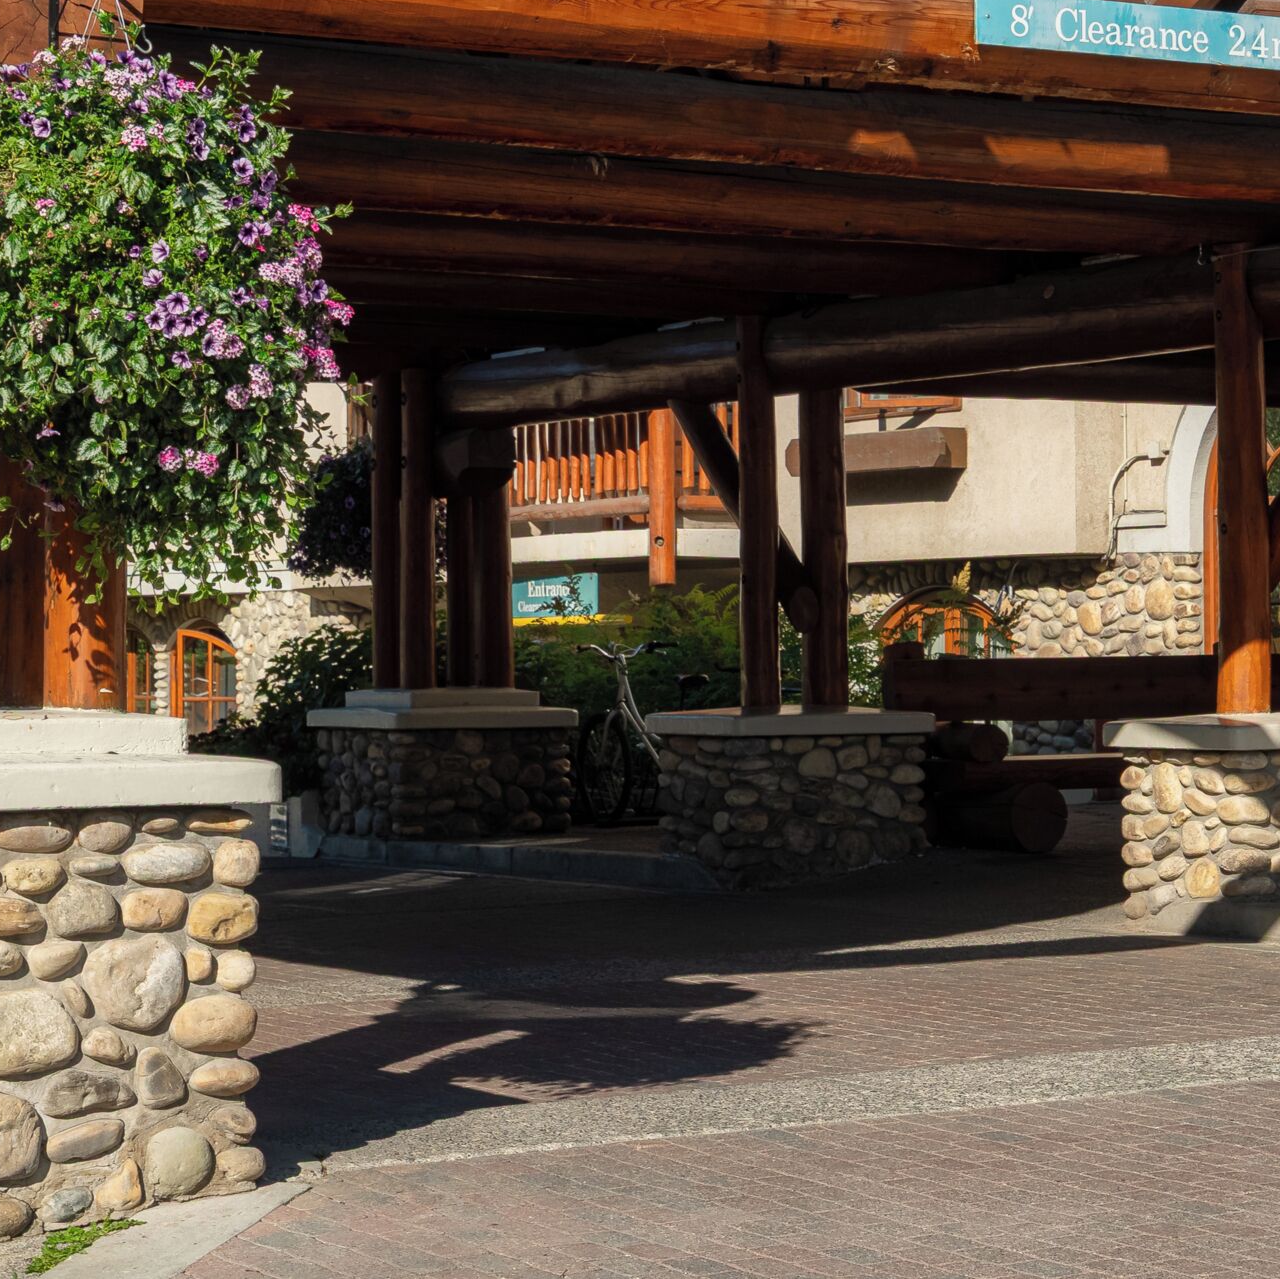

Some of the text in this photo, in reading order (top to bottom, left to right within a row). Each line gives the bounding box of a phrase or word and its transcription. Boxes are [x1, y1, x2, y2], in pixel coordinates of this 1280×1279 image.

[1010, 4, 1034, 38] 8'
[1055, 7, 1209, 53] Clearance
[527, 580, 571, 597] Entranc
